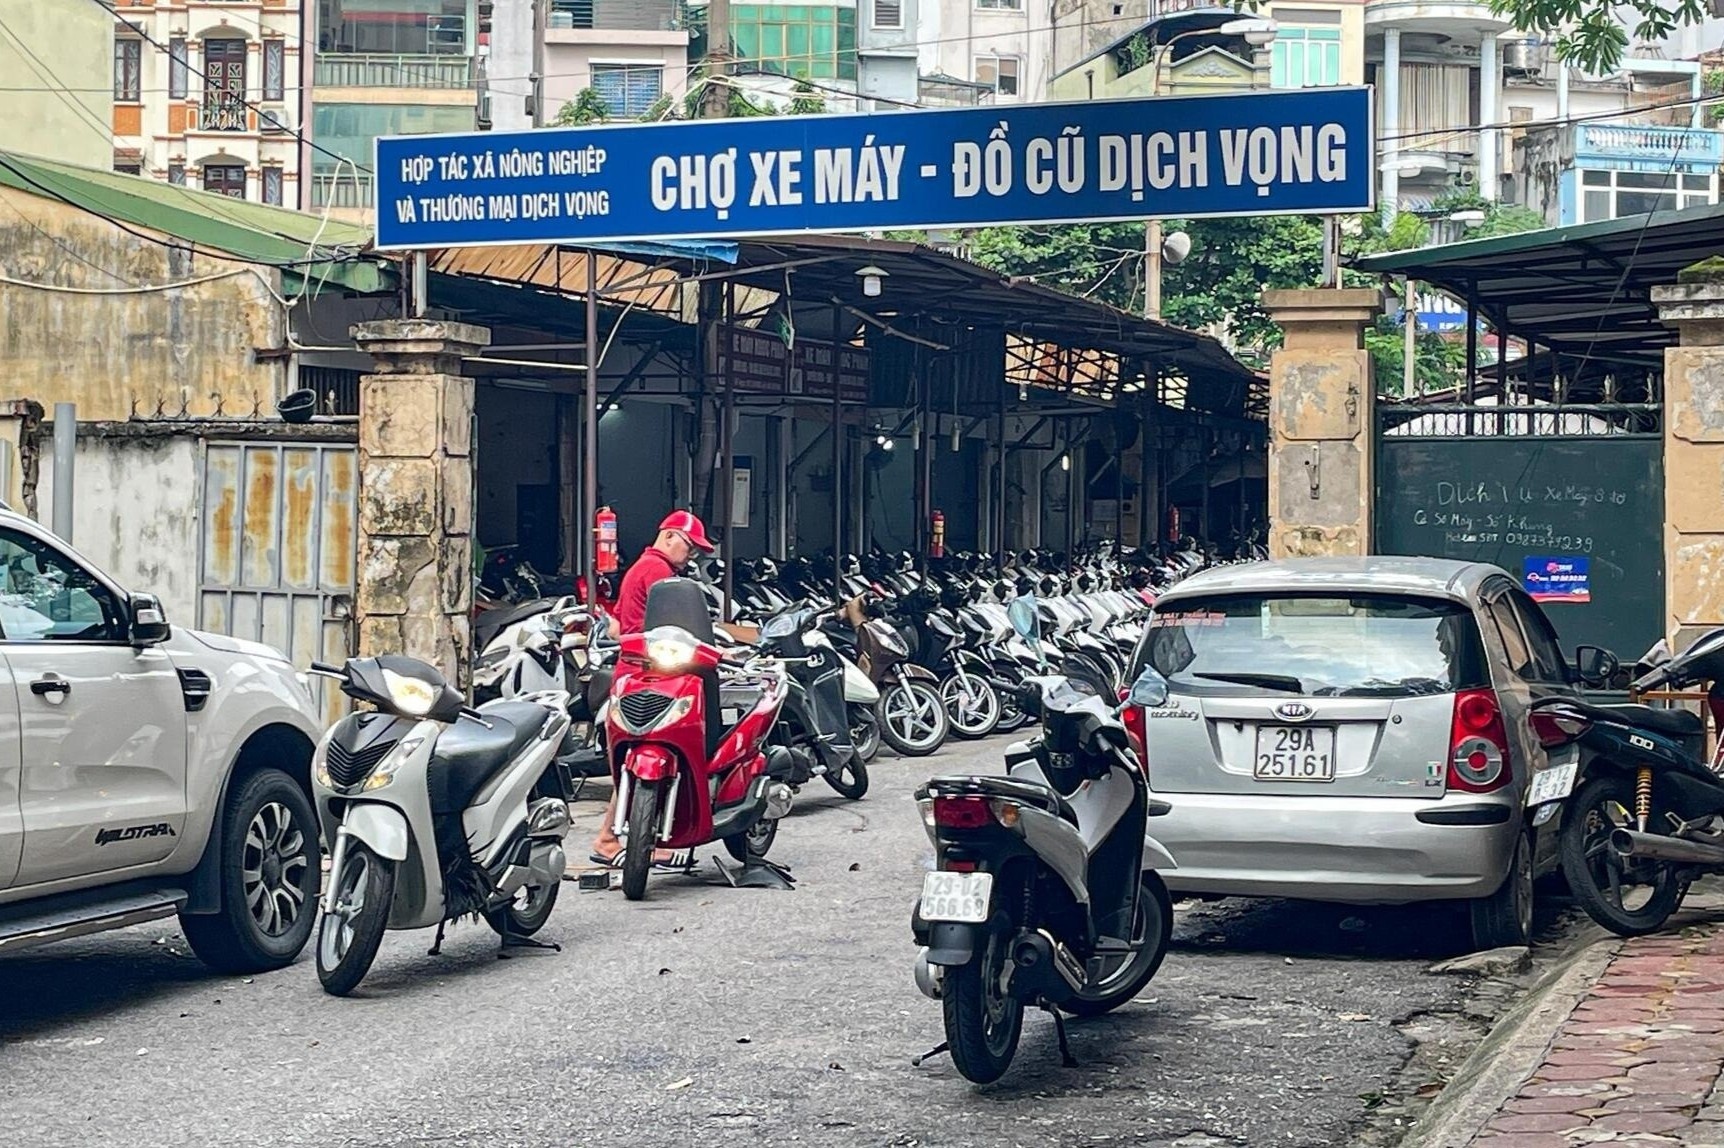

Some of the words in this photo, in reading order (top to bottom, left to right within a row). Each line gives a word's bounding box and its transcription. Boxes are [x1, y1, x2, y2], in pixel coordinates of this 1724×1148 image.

[401, 154, 434, 185] HỢP
[438, 151, 468, 180] TÁC
[472, 150, 495, 179] XÃ
[499, 147, 544, 177] NÔNG
[548, 144, 607, 177] NGHIỆP
[651, 147, 737, 220] CHỢ
[749, 150, 802, 206] XE
[814, 134, 906, 204] MÁY
[920, 164, 937, 178] -
[951, 120, 1012, 198] ĐỒ
[1025, 126, 1085, 195] CŨ
[1099, 130, 1208, 202] DỊCH
[1219, 123, 1346, 197] VỌNG
[396, 195, 417, 223] VÀ
[419, 194, 485, 222] THƯƠNG
[488, 194, 517, 222] MẠI
[522, 192, 560, 221] DỊCH
[564, 190, 610, 220] VỌNG
[1275, 729, 1315, 751] 29A
[1629, 735, 1654, 751] 100
[1258, 754, 1328, 776] 251.61
